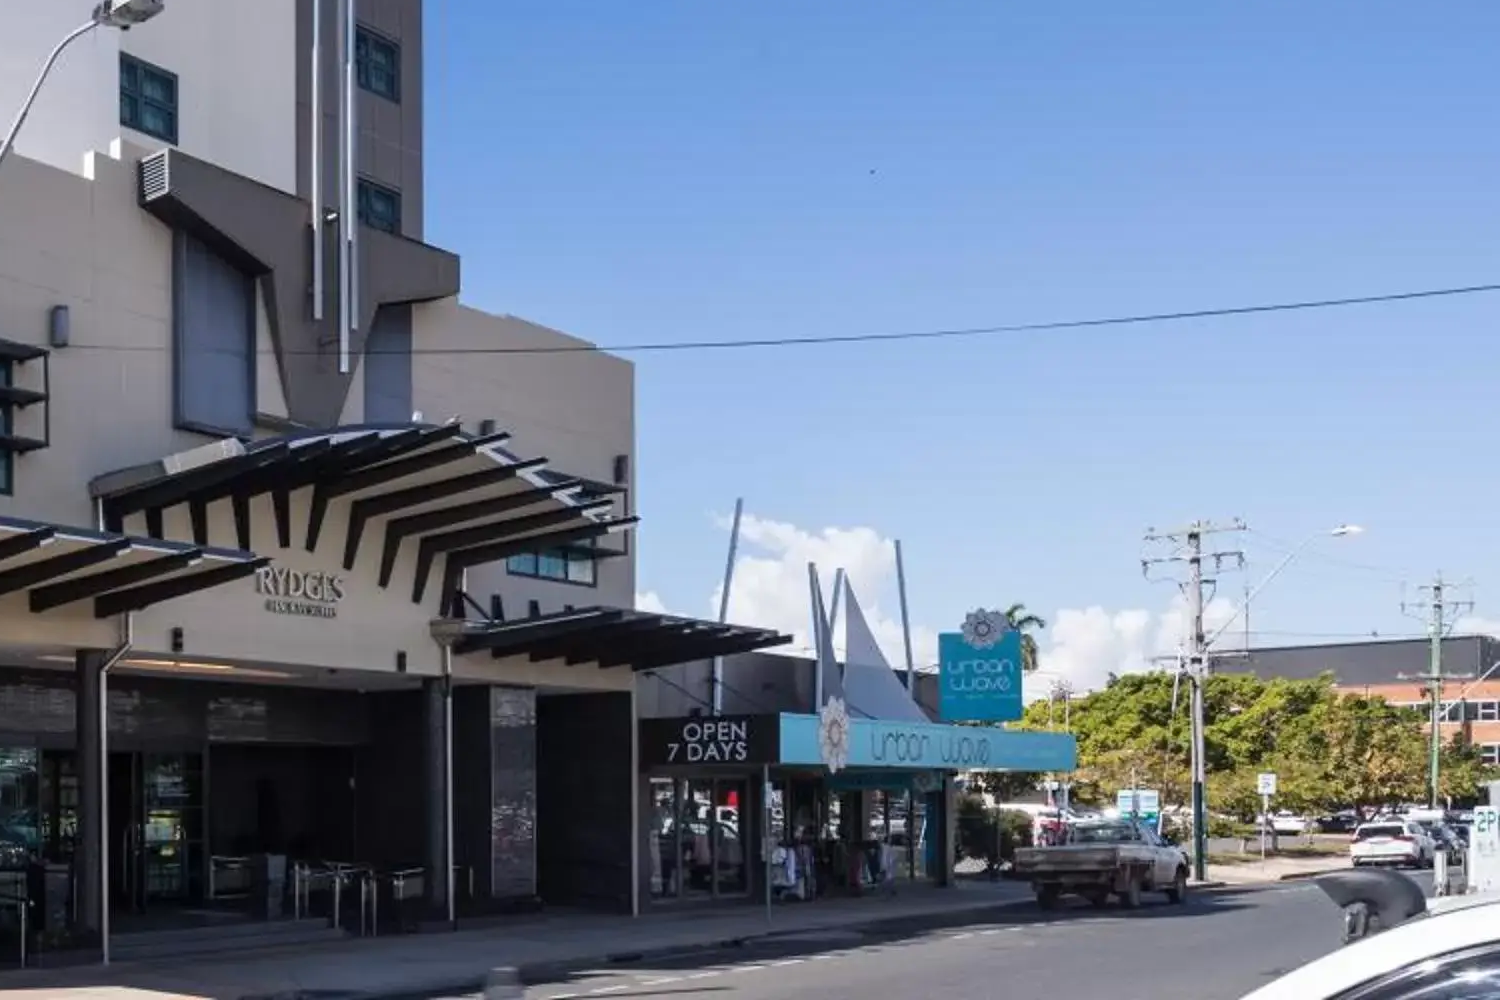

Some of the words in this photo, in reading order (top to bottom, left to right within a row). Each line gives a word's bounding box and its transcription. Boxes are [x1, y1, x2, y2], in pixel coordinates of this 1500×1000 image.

[256, 566, 346, 602] RYDGES
[947, 657, 1015, 675] urban
[682, 721, 748, 742] OPEN
[666, 742, 680, 761] 7
[686, 741, 749, 762] DAYS
[1477, 811, 1497, 833] 2P
